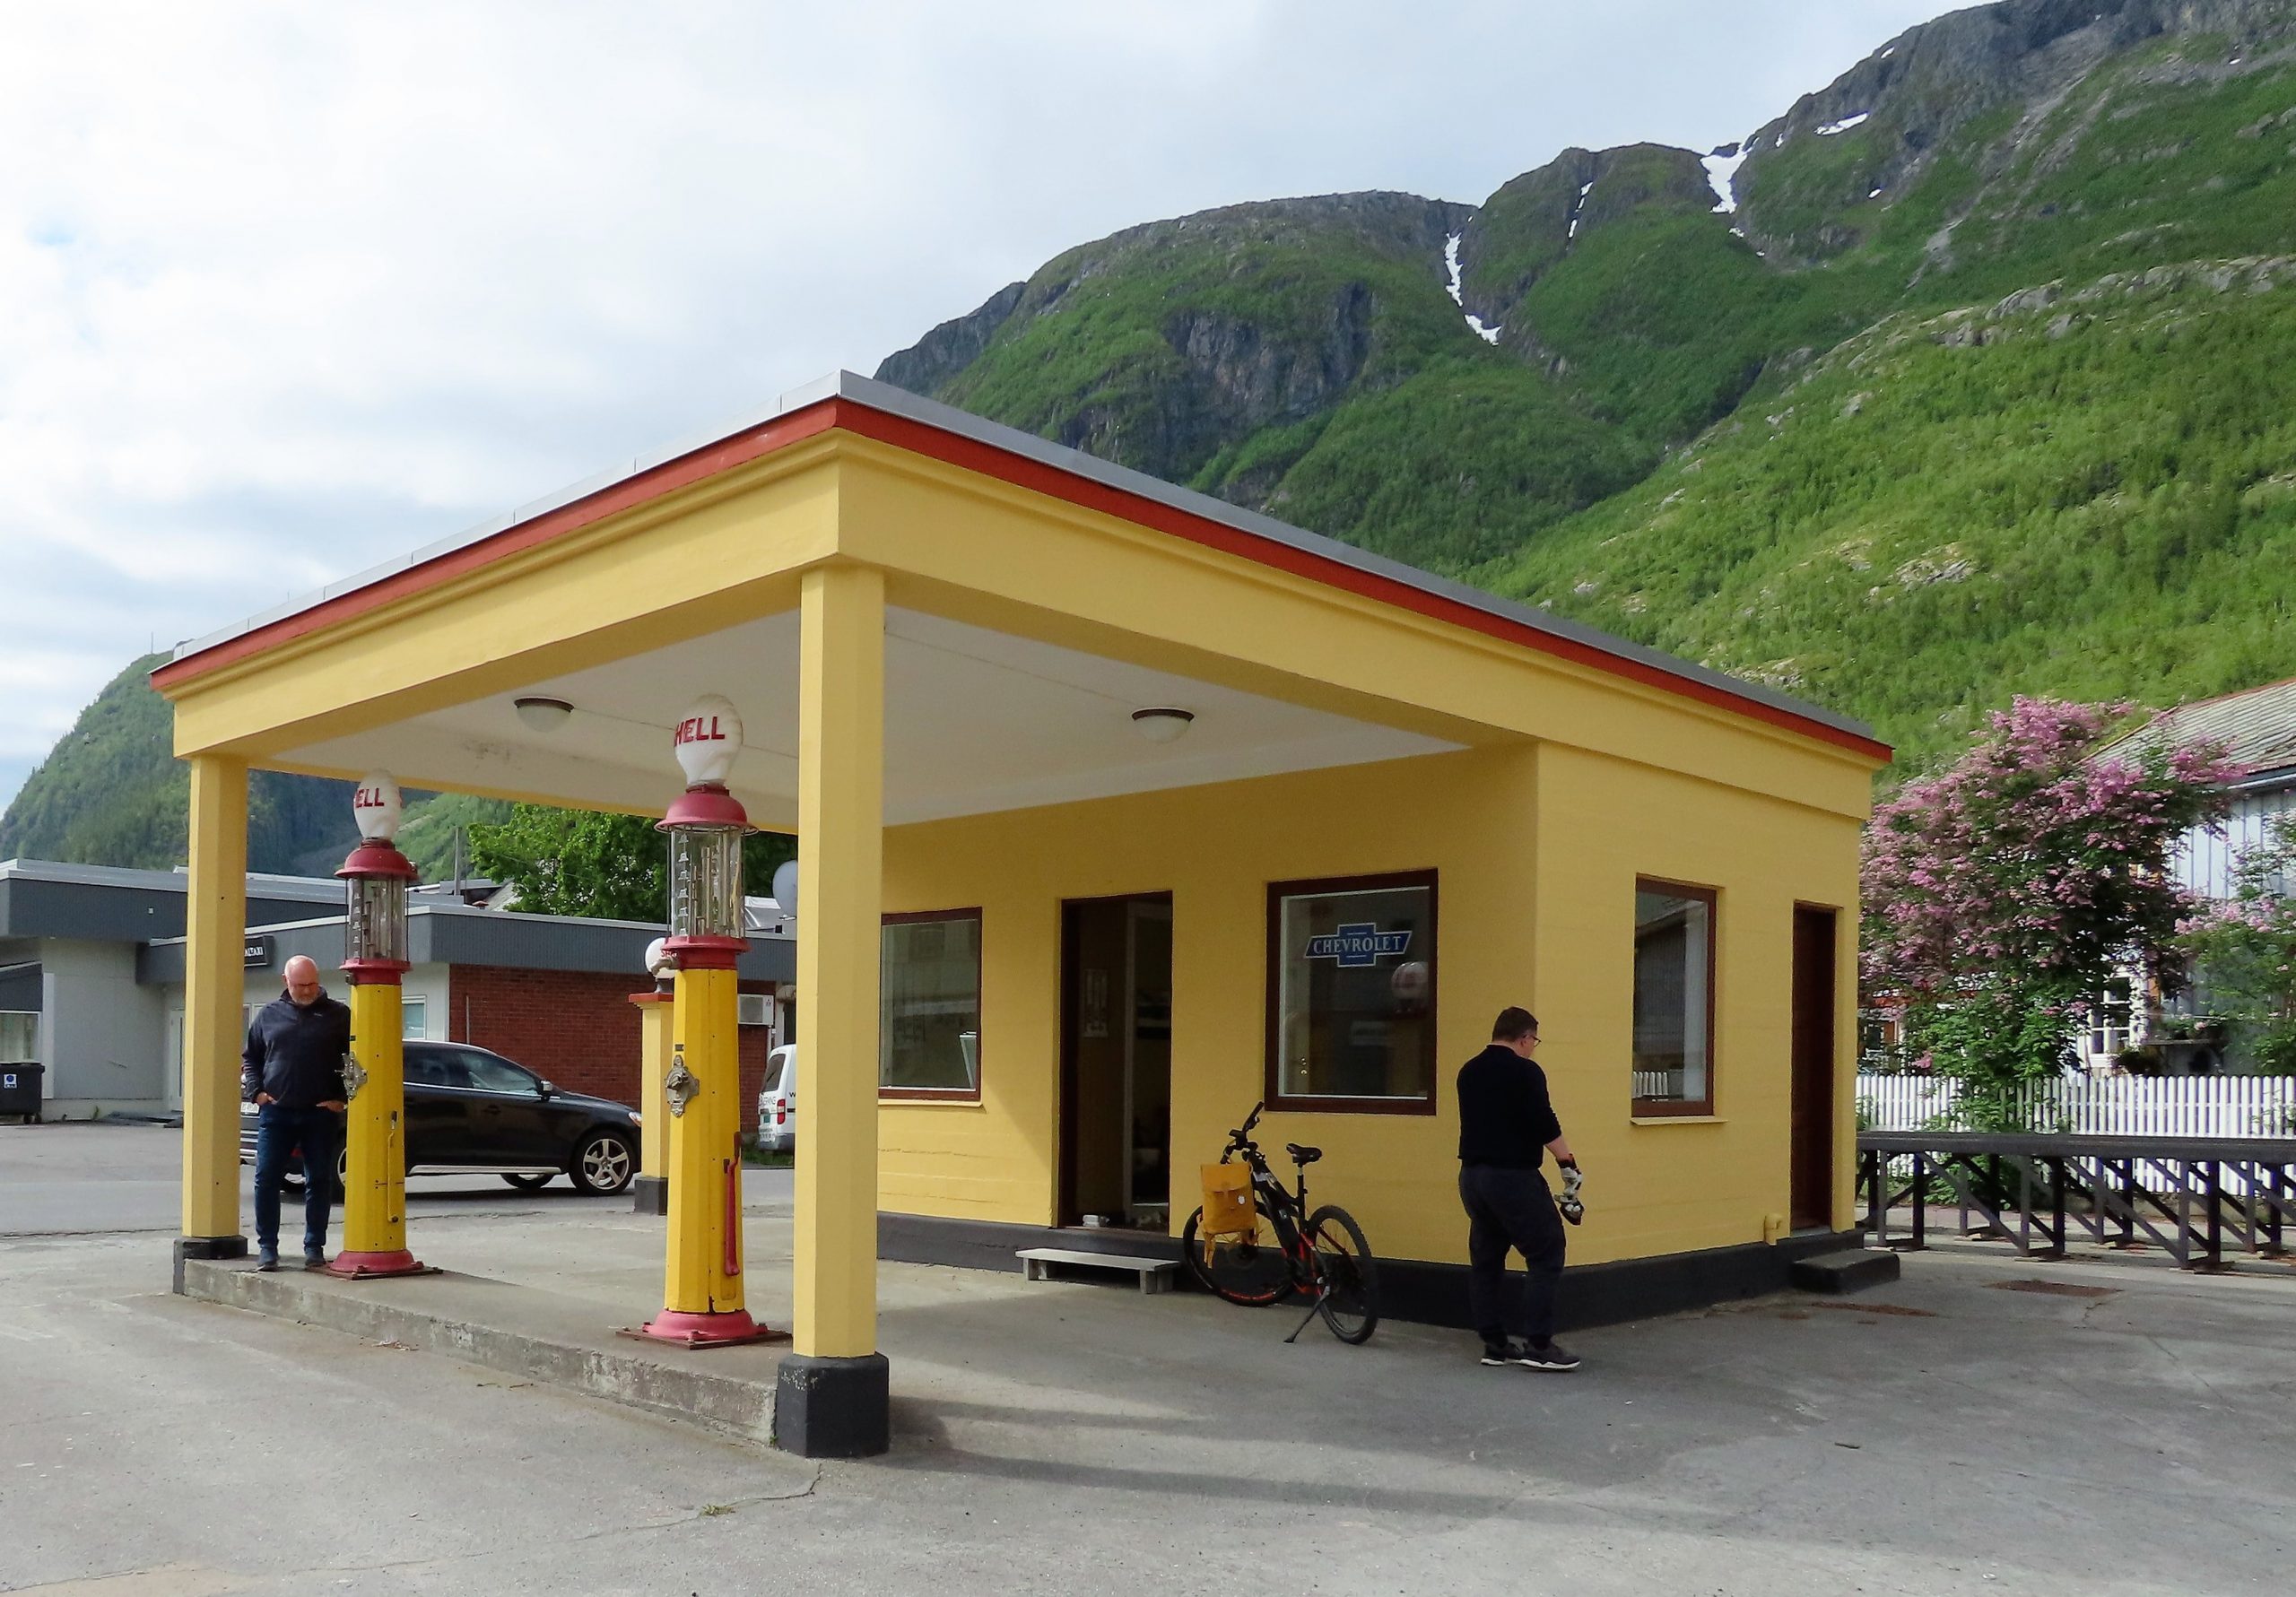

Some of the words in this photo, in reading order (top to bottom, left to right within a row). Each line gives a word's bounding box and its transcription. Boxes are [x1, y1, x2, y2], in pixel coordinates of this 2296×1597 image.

[674, 716, 725, 747] HELL
[355, 788, 384, 808] ELL
[1313, 936, 1401, 953] CHEVROLET
